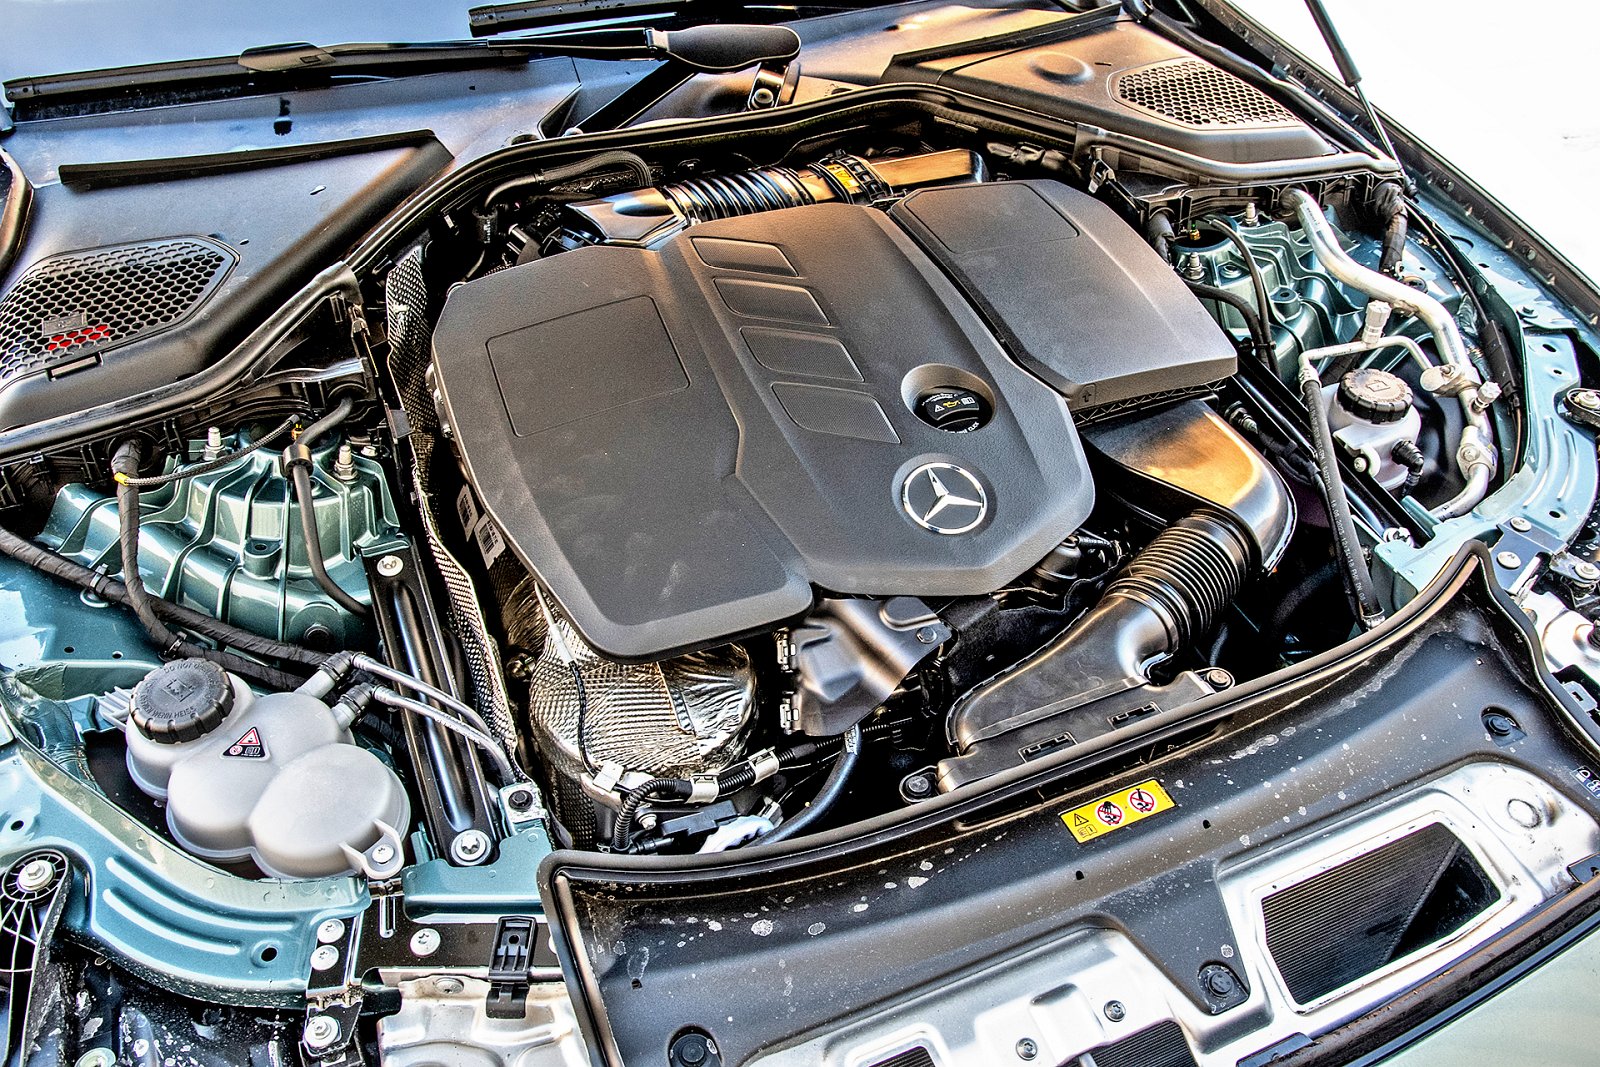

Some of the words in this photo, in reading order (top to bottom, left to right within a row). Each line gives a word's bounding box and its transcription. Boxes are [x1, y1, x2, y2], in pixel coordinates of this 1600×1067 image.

[163, 665, 175, 674] DO
[151, 709, 173, 719] WENN
[174, 705, 197, 717] HEISS
